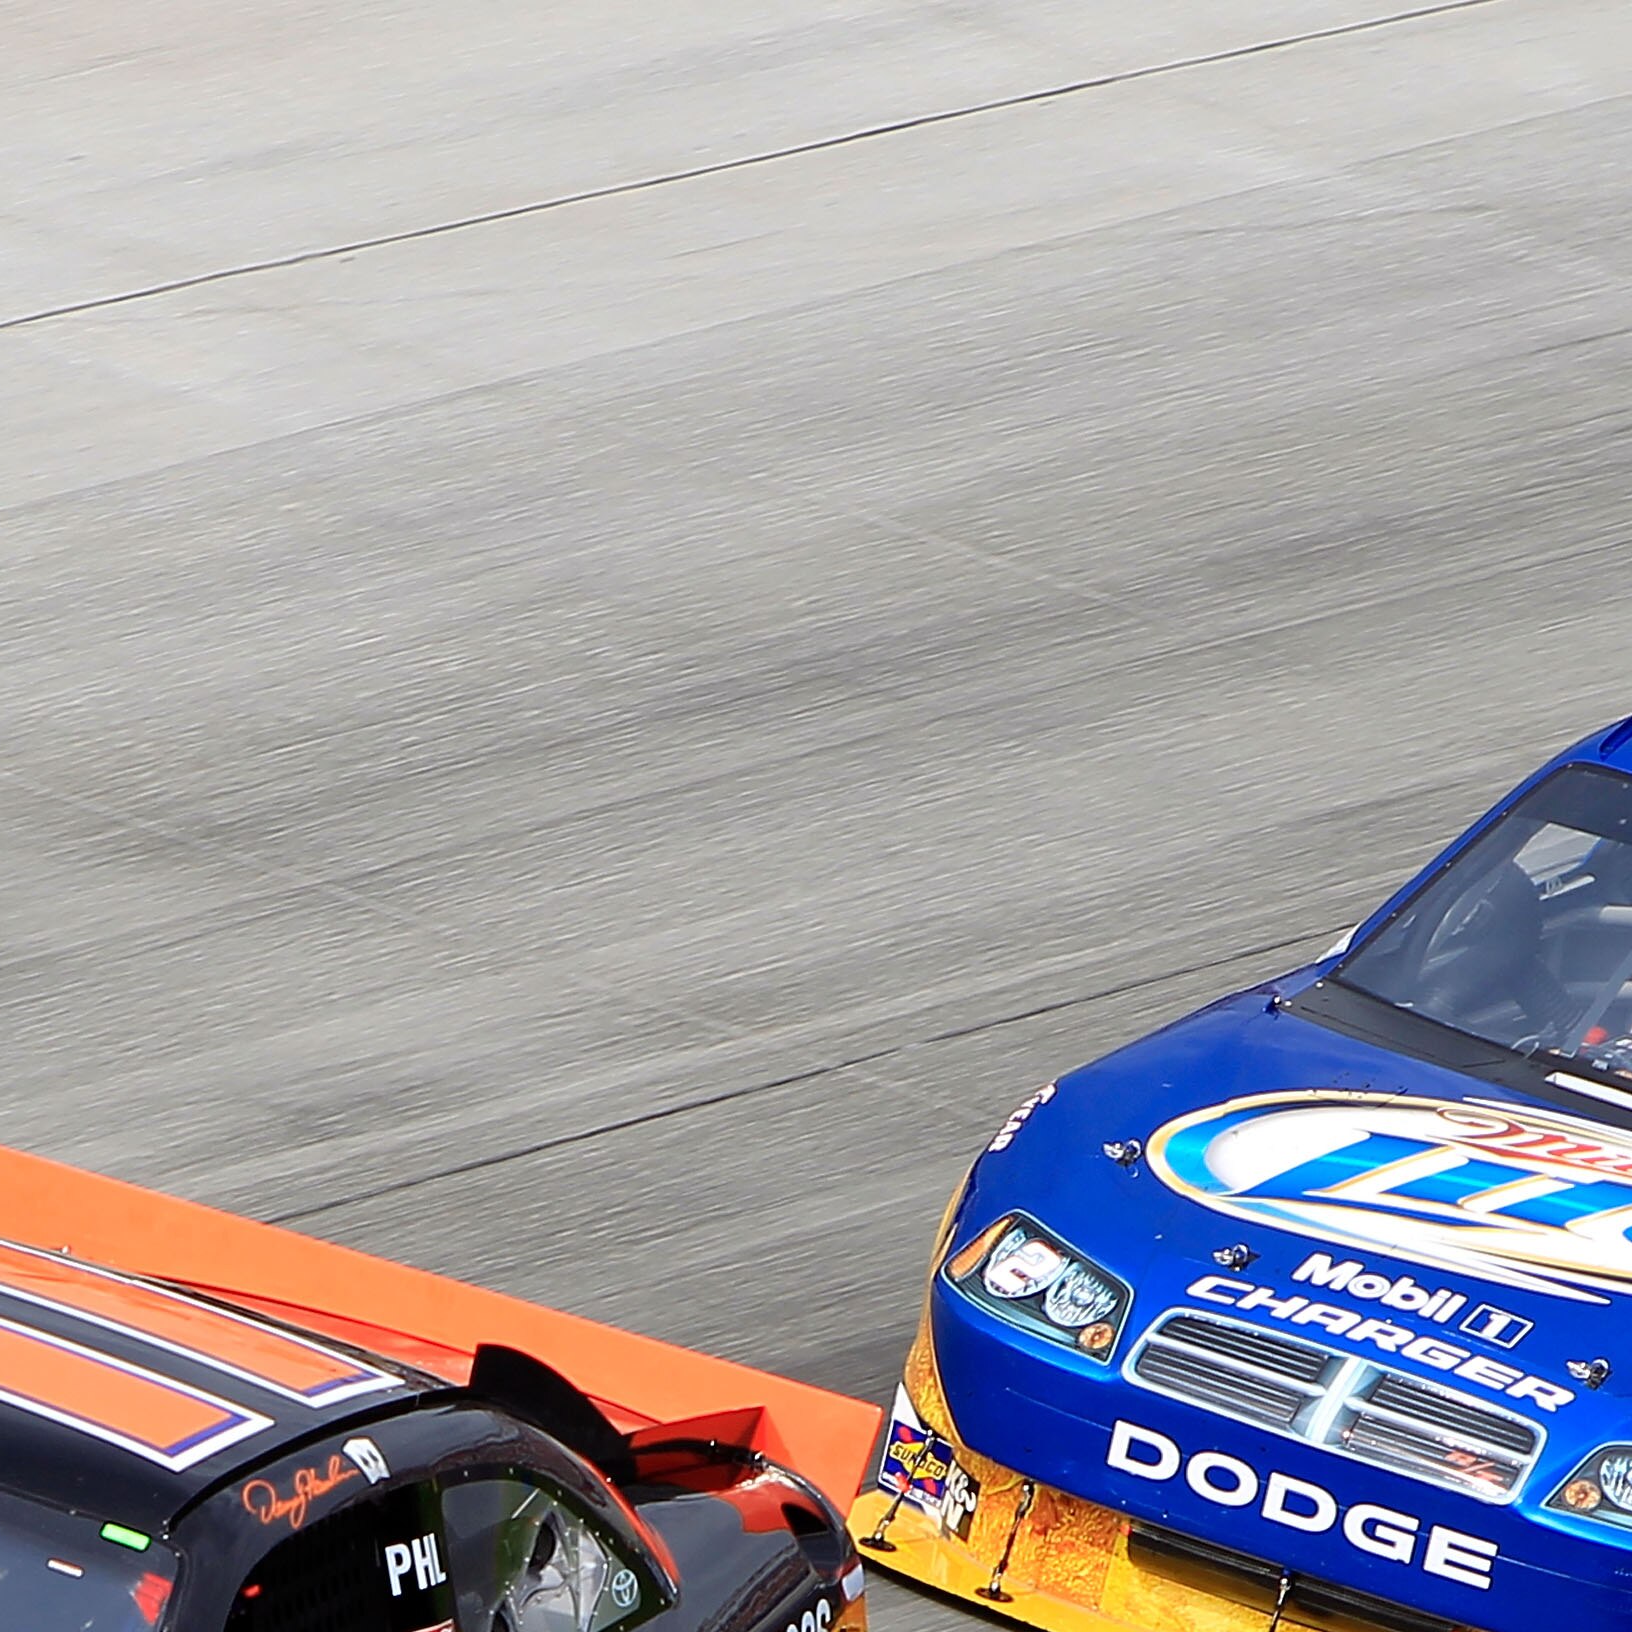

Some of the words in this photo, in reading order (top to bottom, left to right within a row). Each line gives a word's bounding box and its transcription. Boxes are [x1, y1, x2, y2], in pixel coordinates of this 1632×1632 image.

[988, 1236, 1063, 1294] 2
[1292, 1252, 1467, 1322] Mobil
[1185, 1275, 1577, 1413] CHARGER
[1106, 1418, 1501, 1590] DODGE
